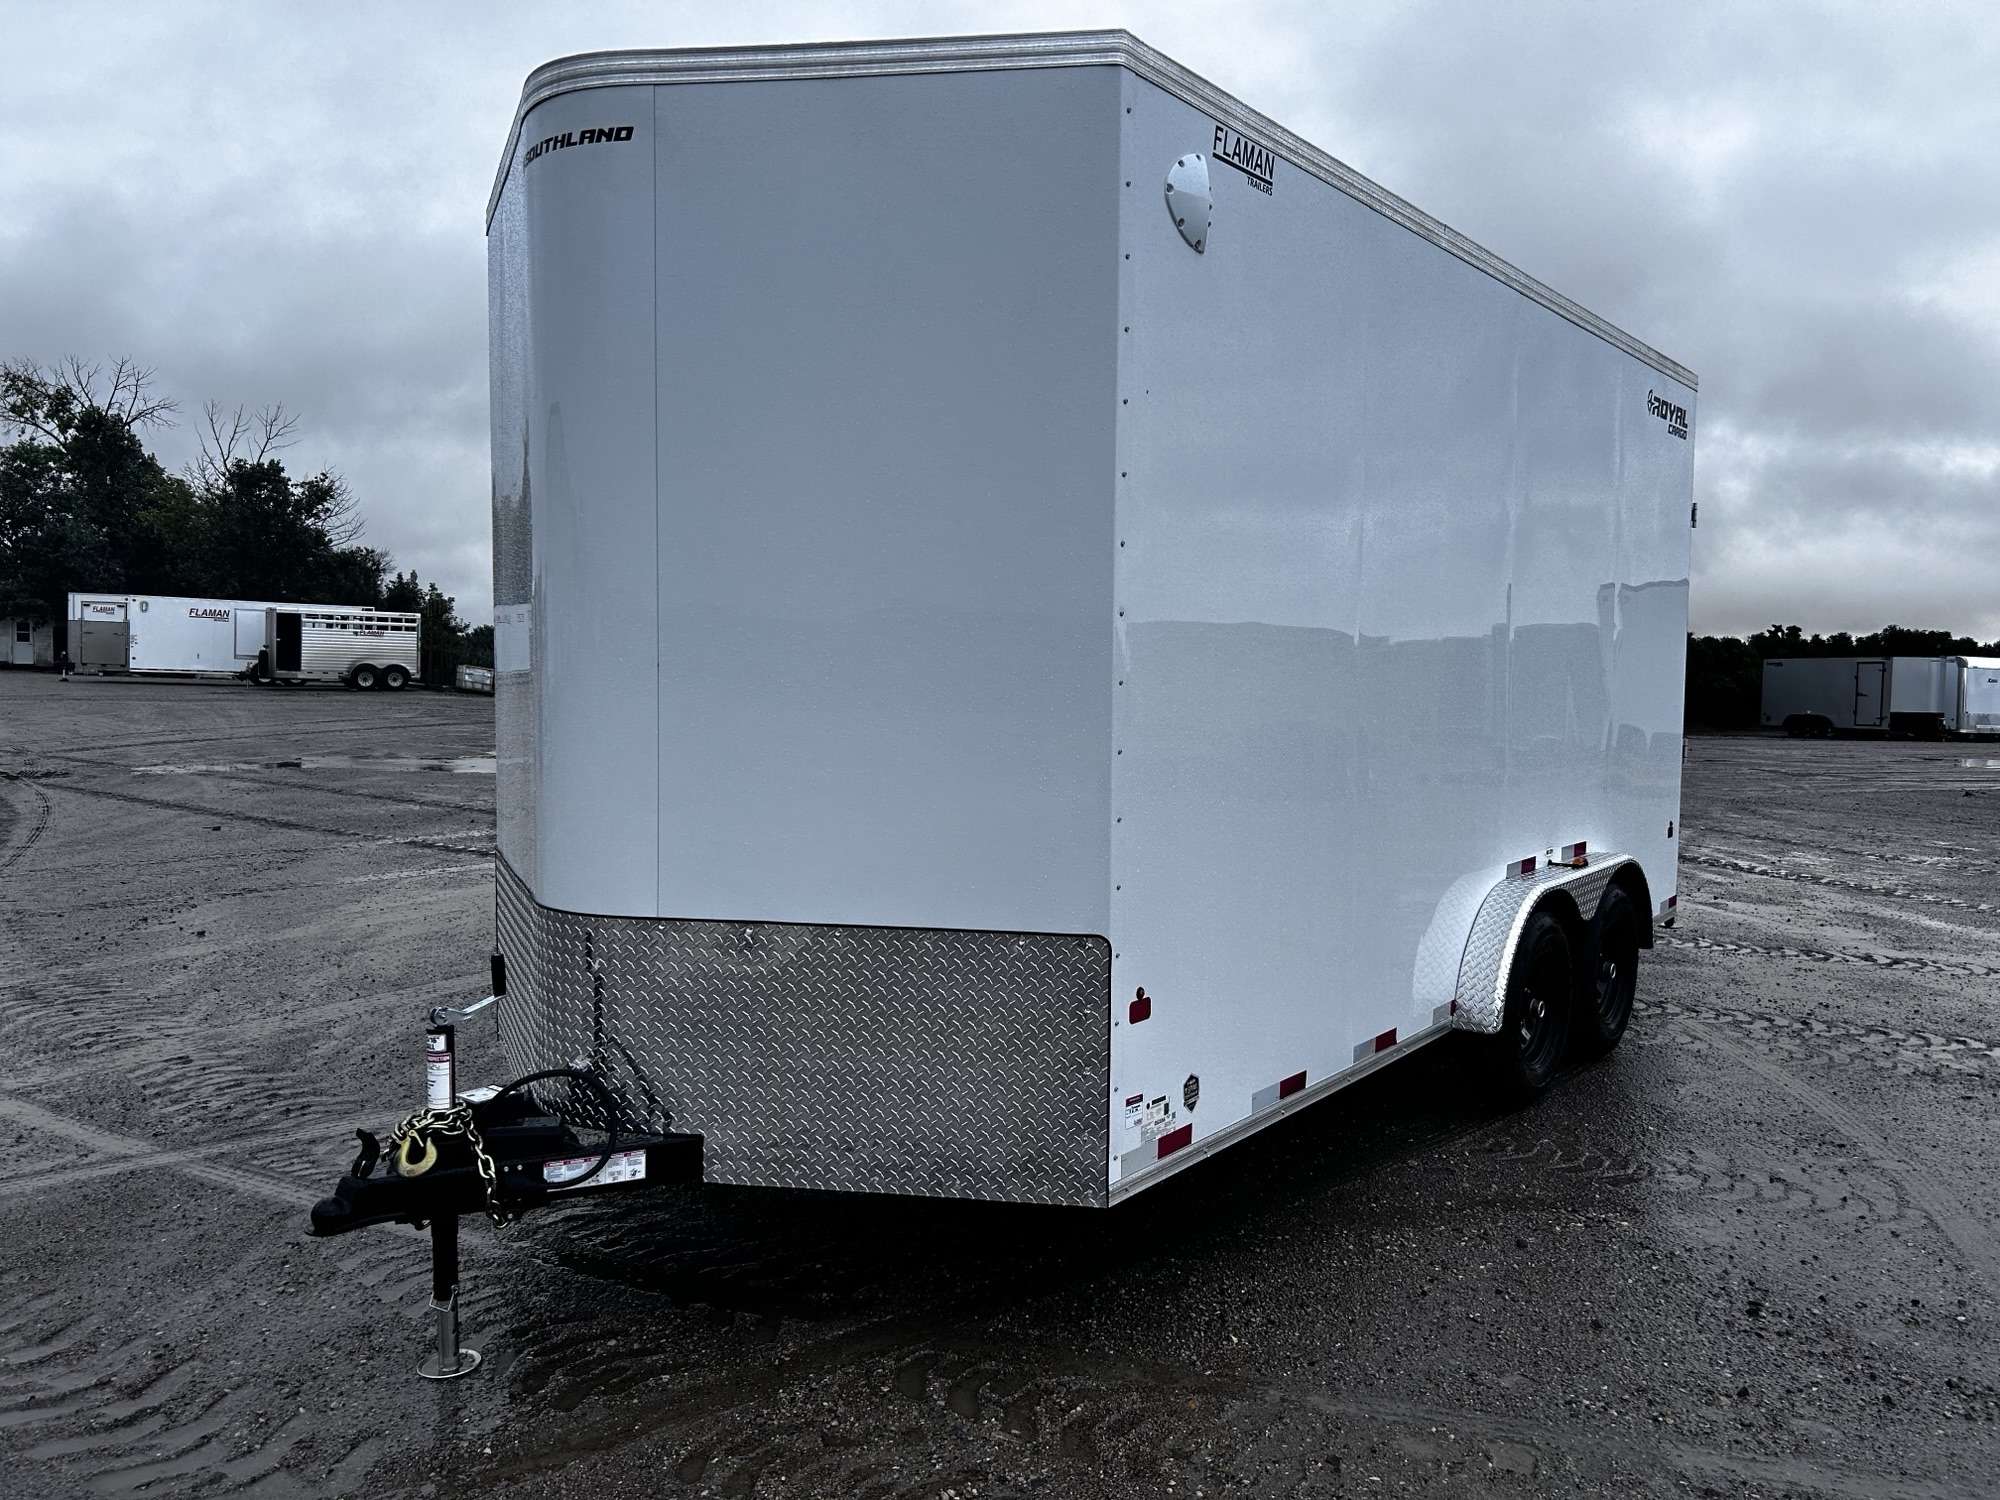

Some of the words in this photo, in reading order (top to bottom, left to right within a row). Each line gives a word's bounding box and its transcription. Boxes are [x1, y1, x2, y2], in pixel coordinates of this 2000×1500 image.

[1213, 124, 1275, 180] FLAMAN
[1247, 176, 1273, 196] TRAILERS
[1651, 394, 1689, 430] ROYAL
[189, 608, 230, 617] FLAMAN
